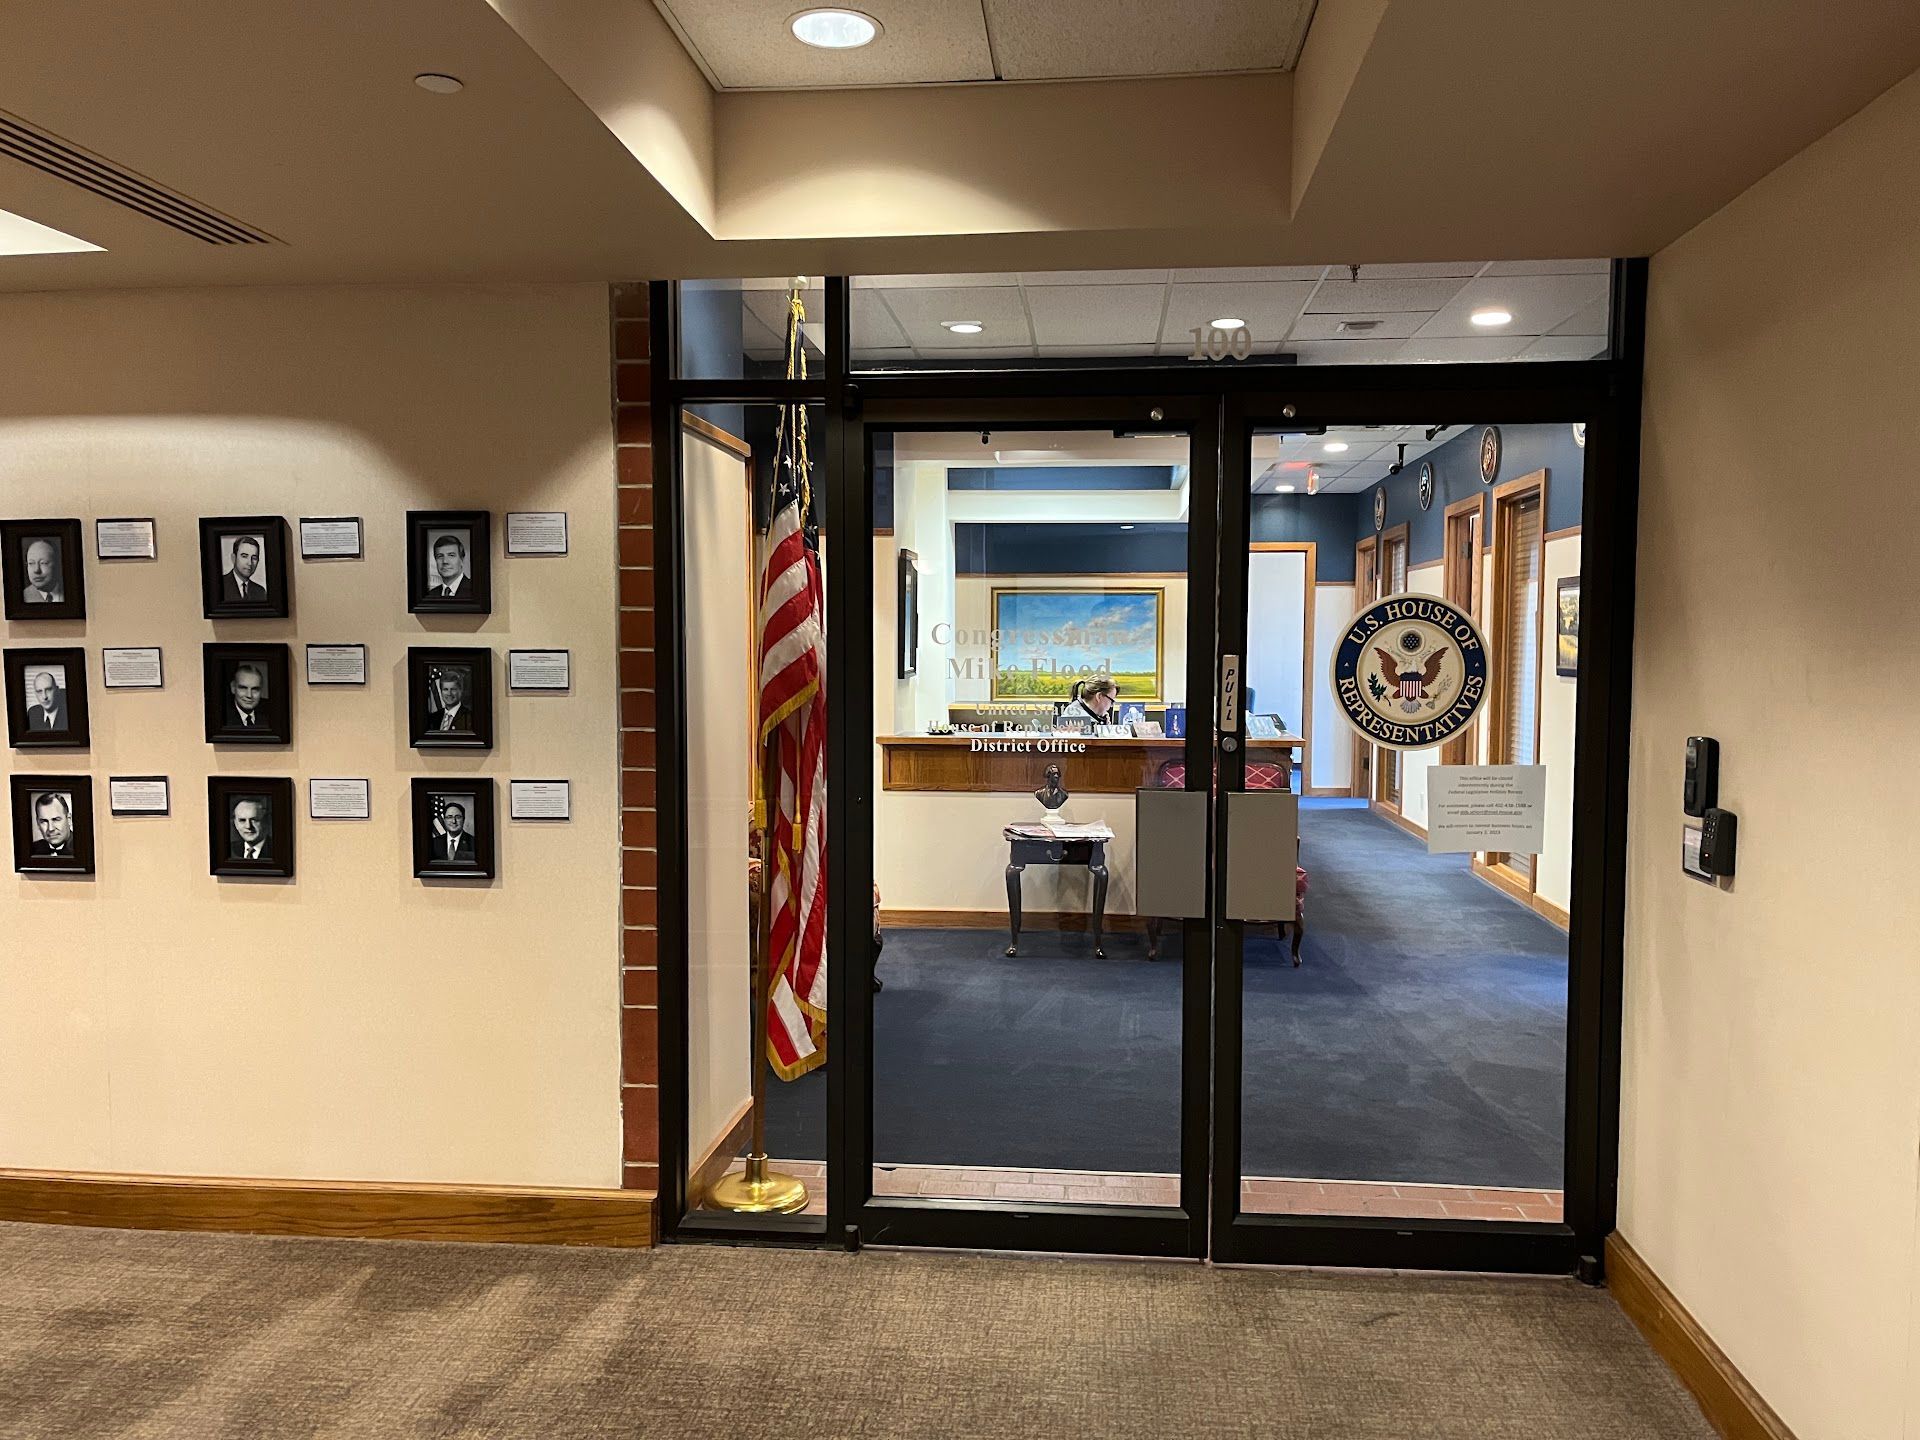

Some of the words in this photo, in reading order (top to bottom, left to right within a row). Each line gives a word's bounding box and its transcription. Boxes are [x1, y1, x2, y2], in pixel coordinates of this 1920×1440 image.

[1187, 328, 1252, 361] 100
[931, 622, 1132, 651] Congressman
[1348, 615, 1384, 644] U.S.
[1385, 600, 1457, 628] HOUSE
[1454, 624, 1480, 651] OF
[946, 657, 1019, 680] Mike
[1029, 657, 1112, 680] Flood
[1225, 668, 1235, 721] PULL
[1339, 675, 1484, 743] REPRESENTATIVES
[975, 703, 1029, 717] United
[1033, 703, 1083, 717] States
[928, 719, 980, 734] House
[981, 720, 999, 733] of
[1002, 720, 1131, 738] Representatives
[970, 738, 1031, 753] District
[1037, 738, 1086, 753] Office
